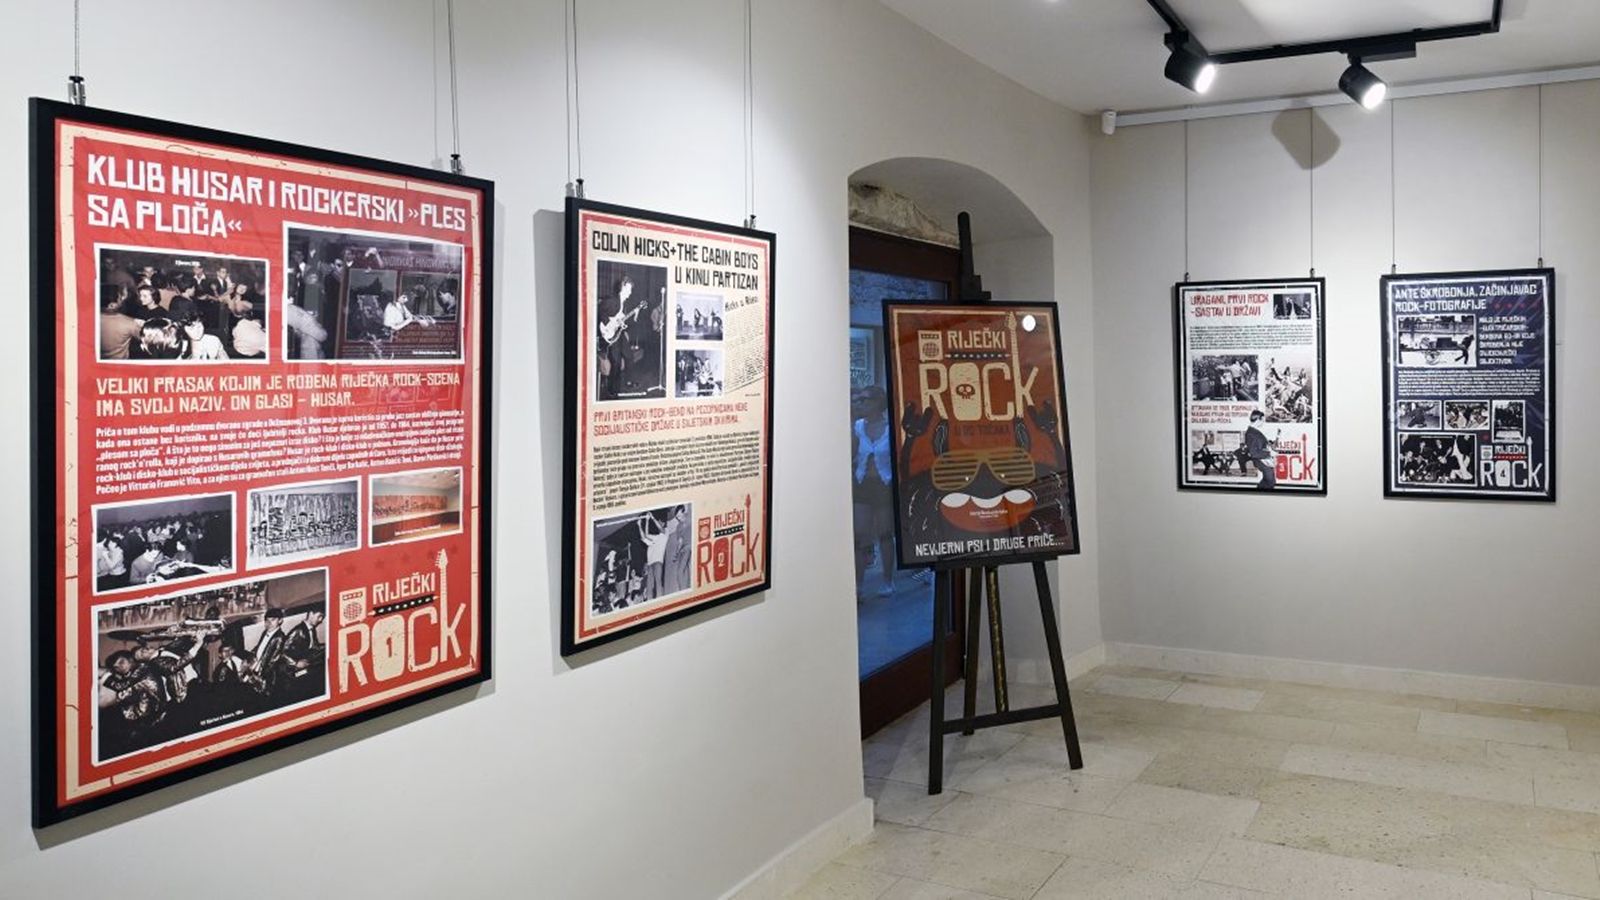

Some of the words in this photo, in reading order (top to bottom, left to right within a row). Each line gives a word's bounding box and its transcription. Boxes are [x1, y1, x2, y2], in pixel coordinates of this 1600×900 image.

[88, 154, 164, 193] KLUB
[172, 167, 263, 205] HUSAR
[269, 182, 276, 206] I
[282, 182, 404, 223] ROCKERSKI
[409, 207, 465, 232] »PLES
[88, 194, 129, 228] SA
[137, 200, 242, 238] PLOČA«
[592, 231, 630, 254] COLIN
[702, 246, 731, 266] CABIN
[734, 251, 758, 270] BOYS
[675, 266, 682, 283] U
[686, 267, 710, 286] KINU
[713, 270, 758, 290] PARTIZAN
[1227, 294, 1246, 304] PRVI
[1248, 293, 1269, 304] ROCK
[1395, 288, 1419, 299] ANTE
[1480, 284, 1536, 296] ZAČINJAVAC
[1226, 307, 1231, 316] U
[1233, 305, 1261, 316] DRŽAVI
[1395, 300, 1487, 312] ROCK-FOTOGRAFIJE
[948, 328, 1006, 348] RIJEČKI
[96, 378, 148, 395] VELIKI
[154, 376, 214, 393] PRASAK
[220, 376, 261, 392] KOJIM
[266, 376, 282, 390] JE
[342, 371, 388, 387] RIJEČKA
[393, 372, 460, 386] ROCK-SCENA
[919, 330, 1039, 421] ROCK
[96, 400, 124, 416] IMA
[131, 398, 173, 415] SVOJ
[180, 396, 225, 413] NAZIV.
[231, 396, 250, 410] ON
[256, 393, 292, 410] GLASI
[311, 392, 355, 406] HUSAR.
[96, 427, 115, 437] Priča
[123, 426, 137, 435] tom
[139, 425, 158, 434] klubu
[96, 439, 114, 448] kada
[116, 438, 130, 446] ona
[133, 436, 157, 446] ostane
[160, 435, 172, 444] bez
[96, 461, 118, 471] ranog
[164, 457, 177, 466] koji
[1480, 445, 1542, 488] ROCK
[714, 508, 744, 529] RIJEČKI
[697, 506, 759, 588] ROCK
[916, 540, 964, 556] NEVJERNI
[967, 540, 982, 552] PSI
[986, 540, 990, 550] I
[994, 536, 1025, 550] DRUGE
[373, 572, 435, 605] RIJEČKI
[338, 568, 466, 694] ROCK
